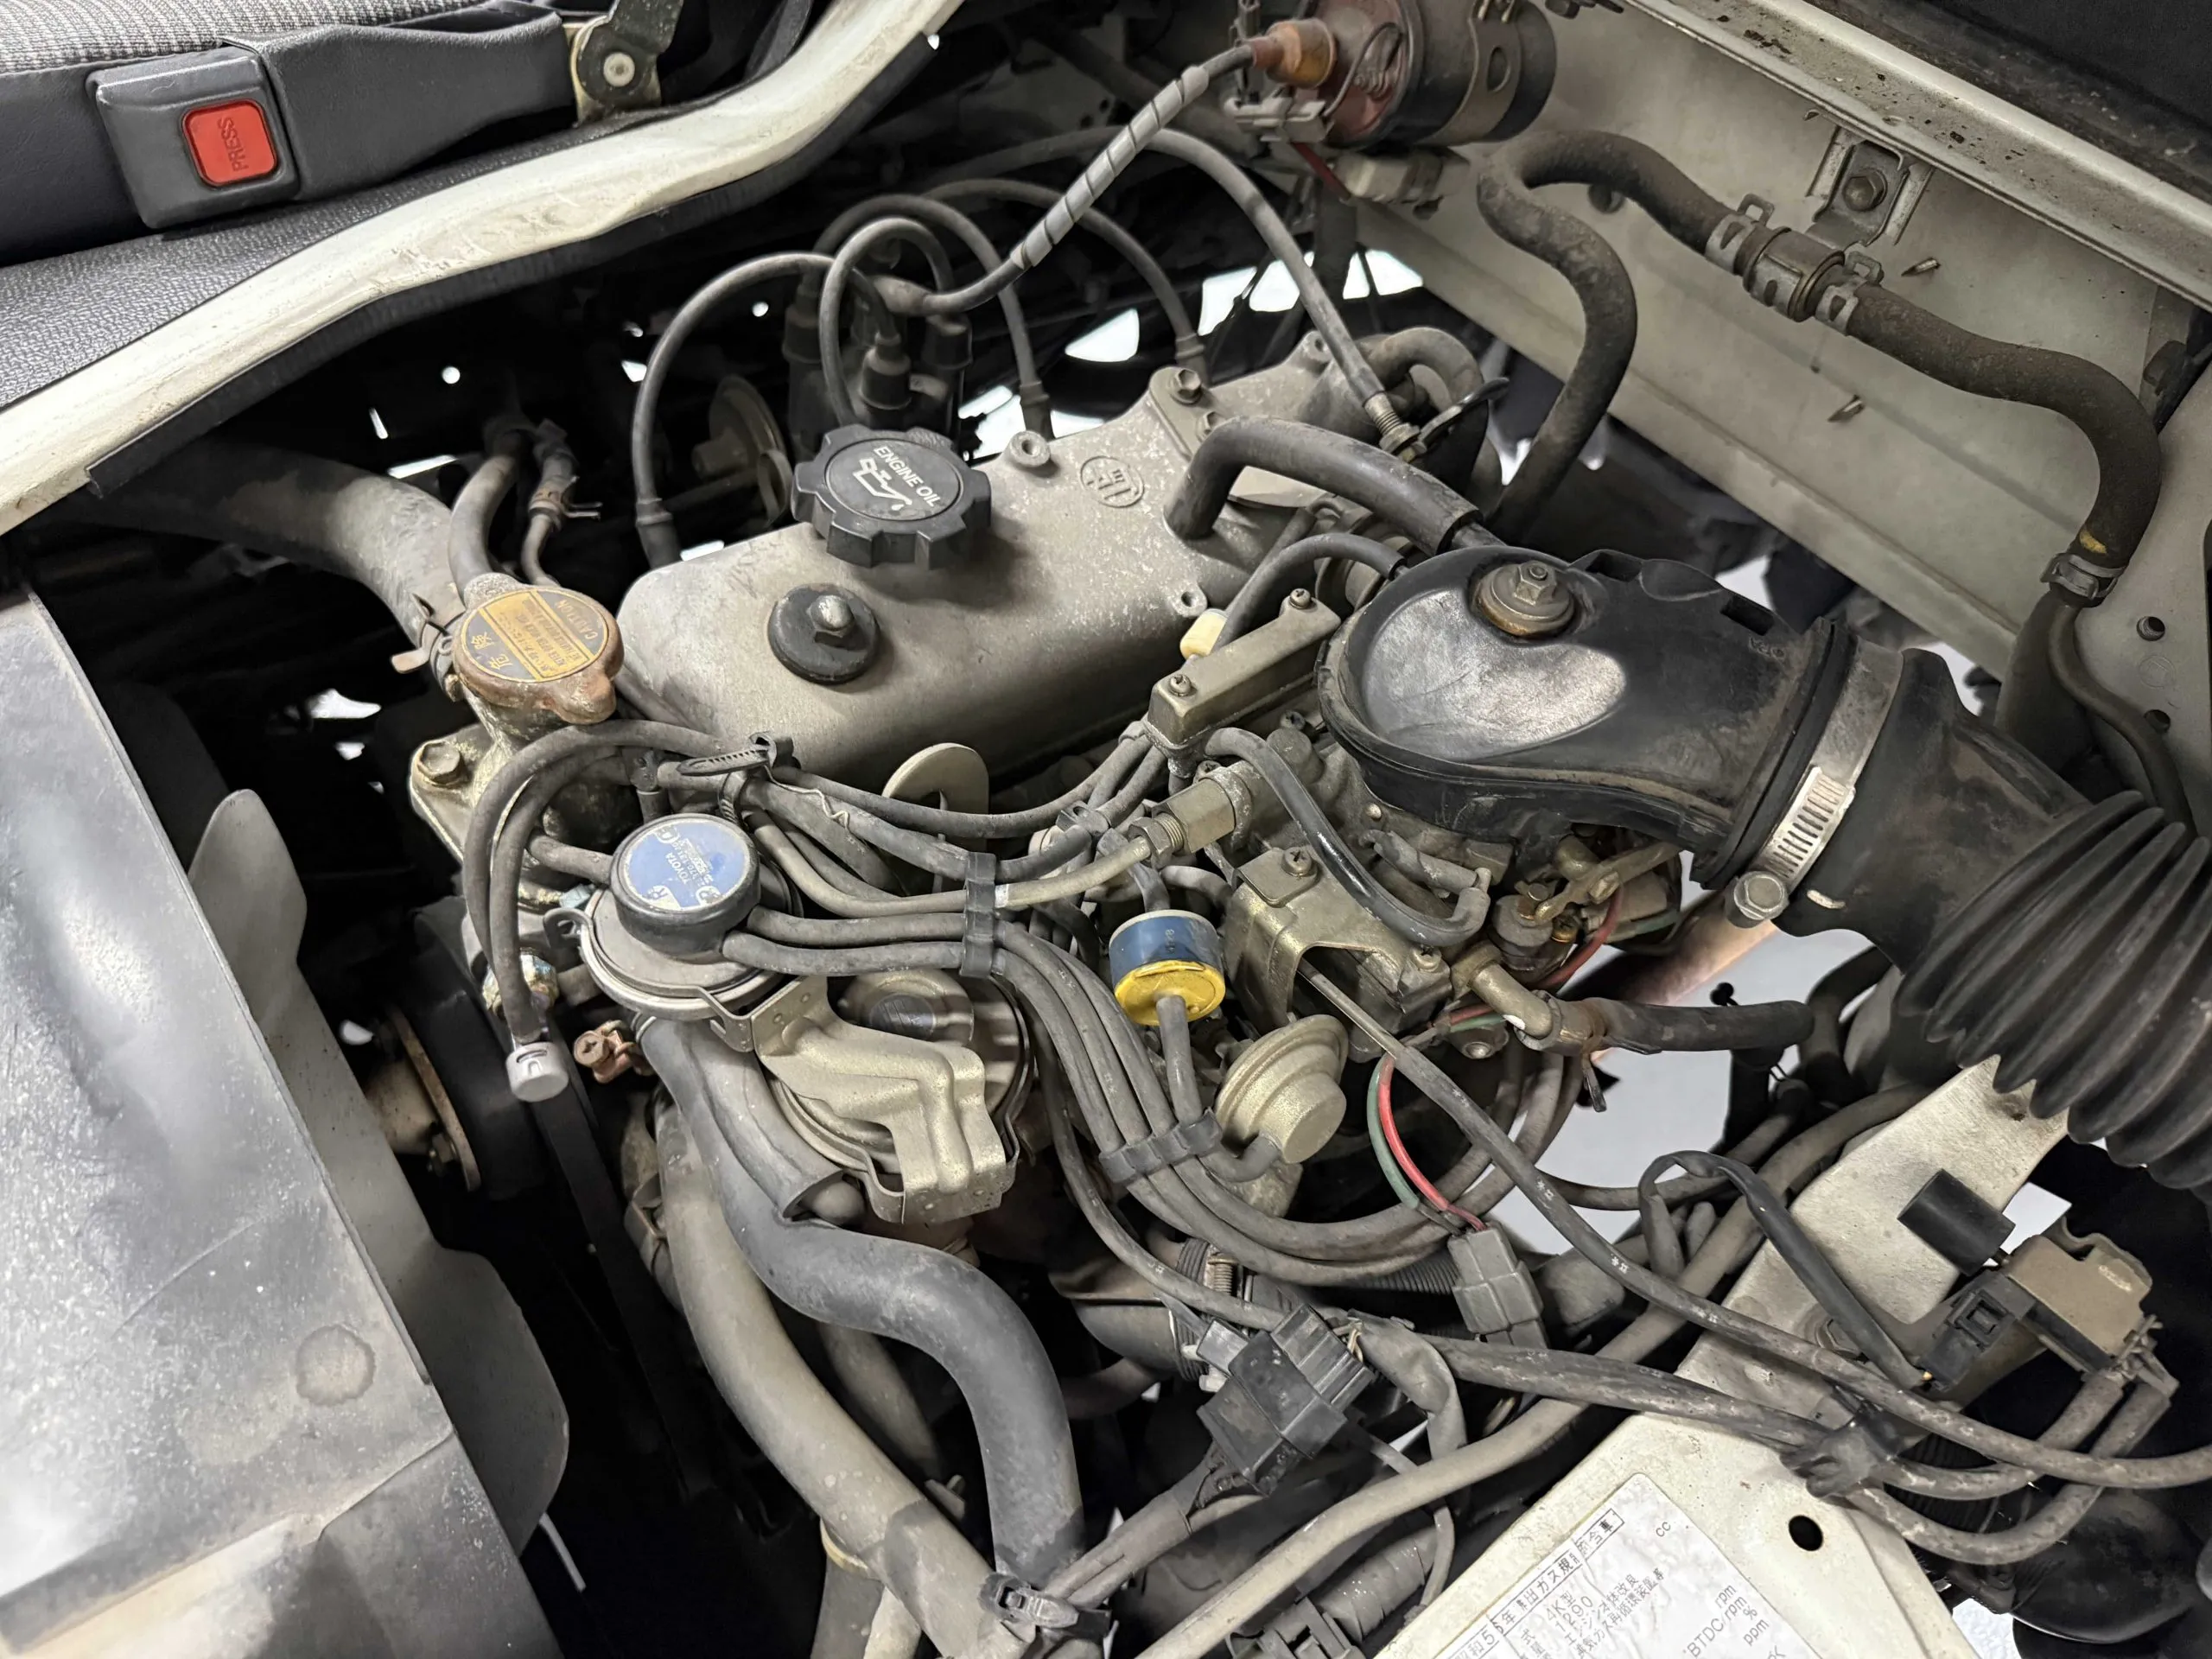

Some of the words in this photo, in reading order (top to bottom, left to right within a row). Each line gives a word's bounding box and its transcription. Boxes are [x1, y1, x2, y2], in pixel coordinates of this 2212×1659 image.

[218, 117, 249, 171] PRESS
[874, 445, 921, 489] ENGINE
[916, 482, 944, 507] OIL
[558, 600, 598, 640] CAUTION
[665, 852, 690, 884] TOYOTA
[1656, 1522, 1672, 1537] cc
[1547, 1591, 1577, 1621] 4K型
[1715, 1585, 1737, 1609] rpm
[1742, 1605, 1758, 1620] %
[1555, 1596, 1593, 1632] 1290
[1743, 1619, 1770, 1646] ppm
